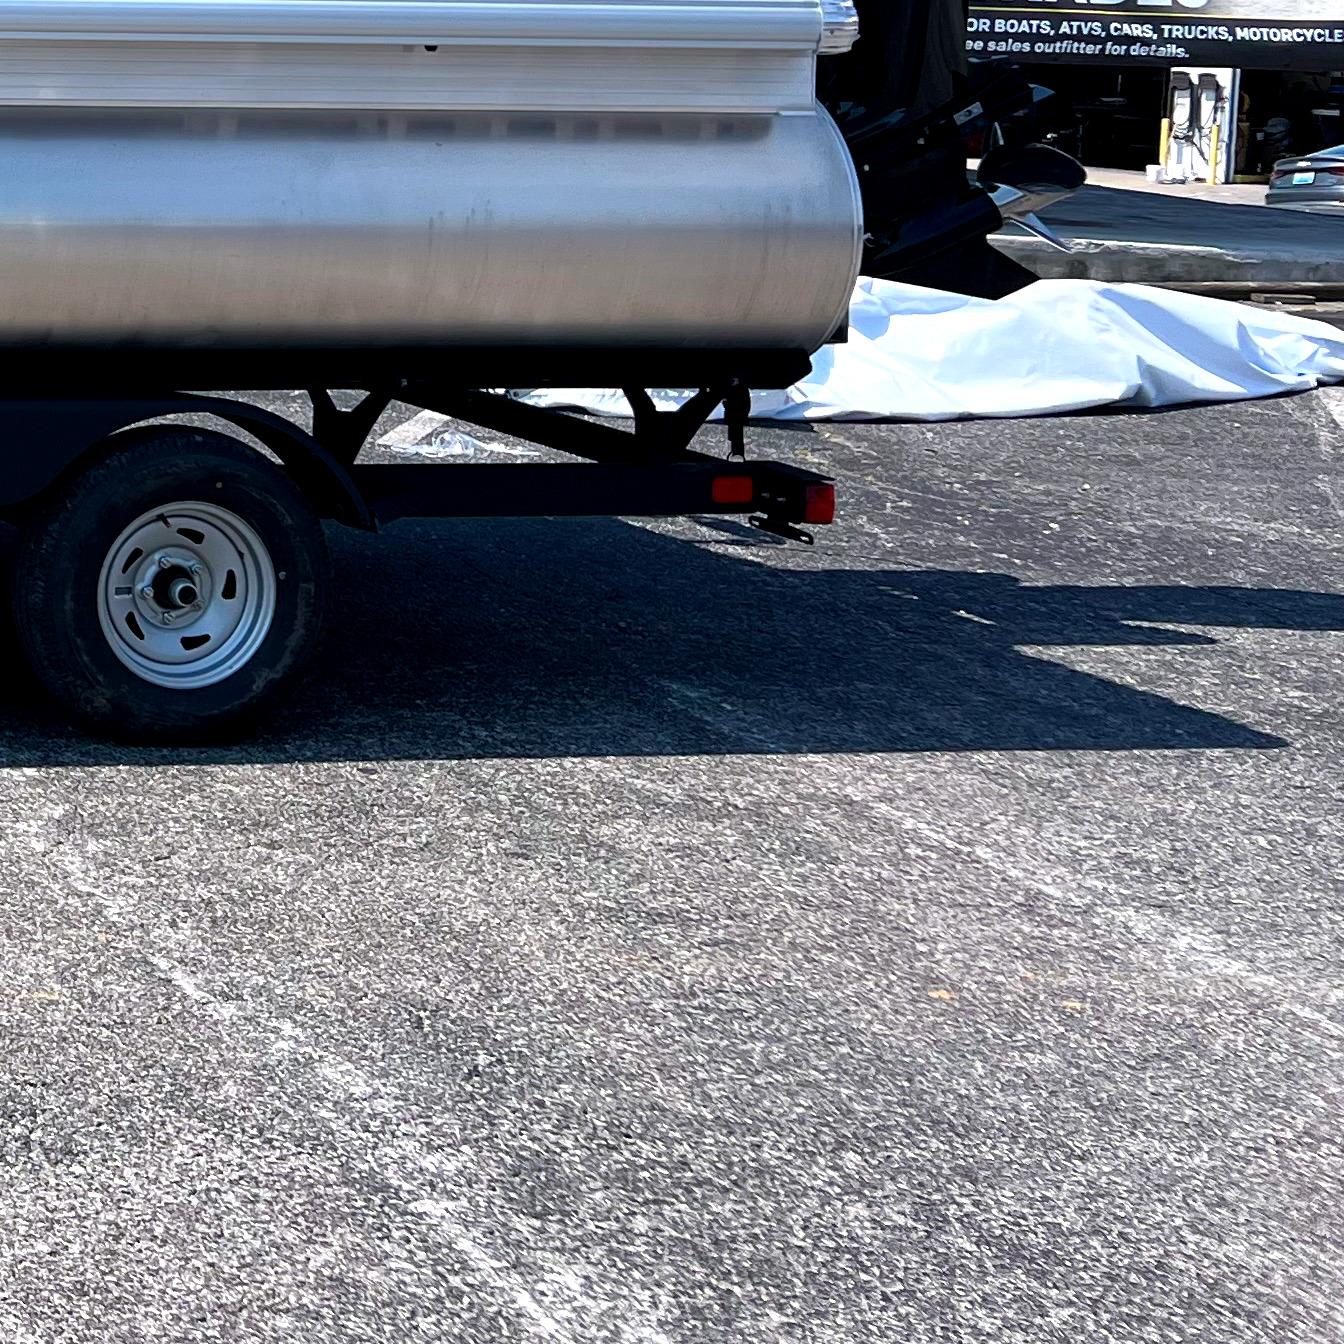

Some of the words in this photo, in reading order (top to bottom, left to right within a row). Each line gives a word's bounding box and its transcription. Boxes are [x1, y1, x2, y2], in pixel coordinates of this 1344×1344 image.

[967, 18, 990, 32] OR
[994, 19, 1055, 36] BOATS,
[1059, 21, 1107, 38] ATVS,
[1110, 22, 1159, 40] CARS,
[1161, 24, 1233, 42] TRUCKS,
[1236, 27, 1344, 43] MOTORCYCLE
[965, 40, 984, 51] ee
[987, 39, 1031, 53] sales
[1034, 40, 1103, 55] outfitter
[1105, 41, 1127, 55] for
[1129, 42, 1190, 58] details.
